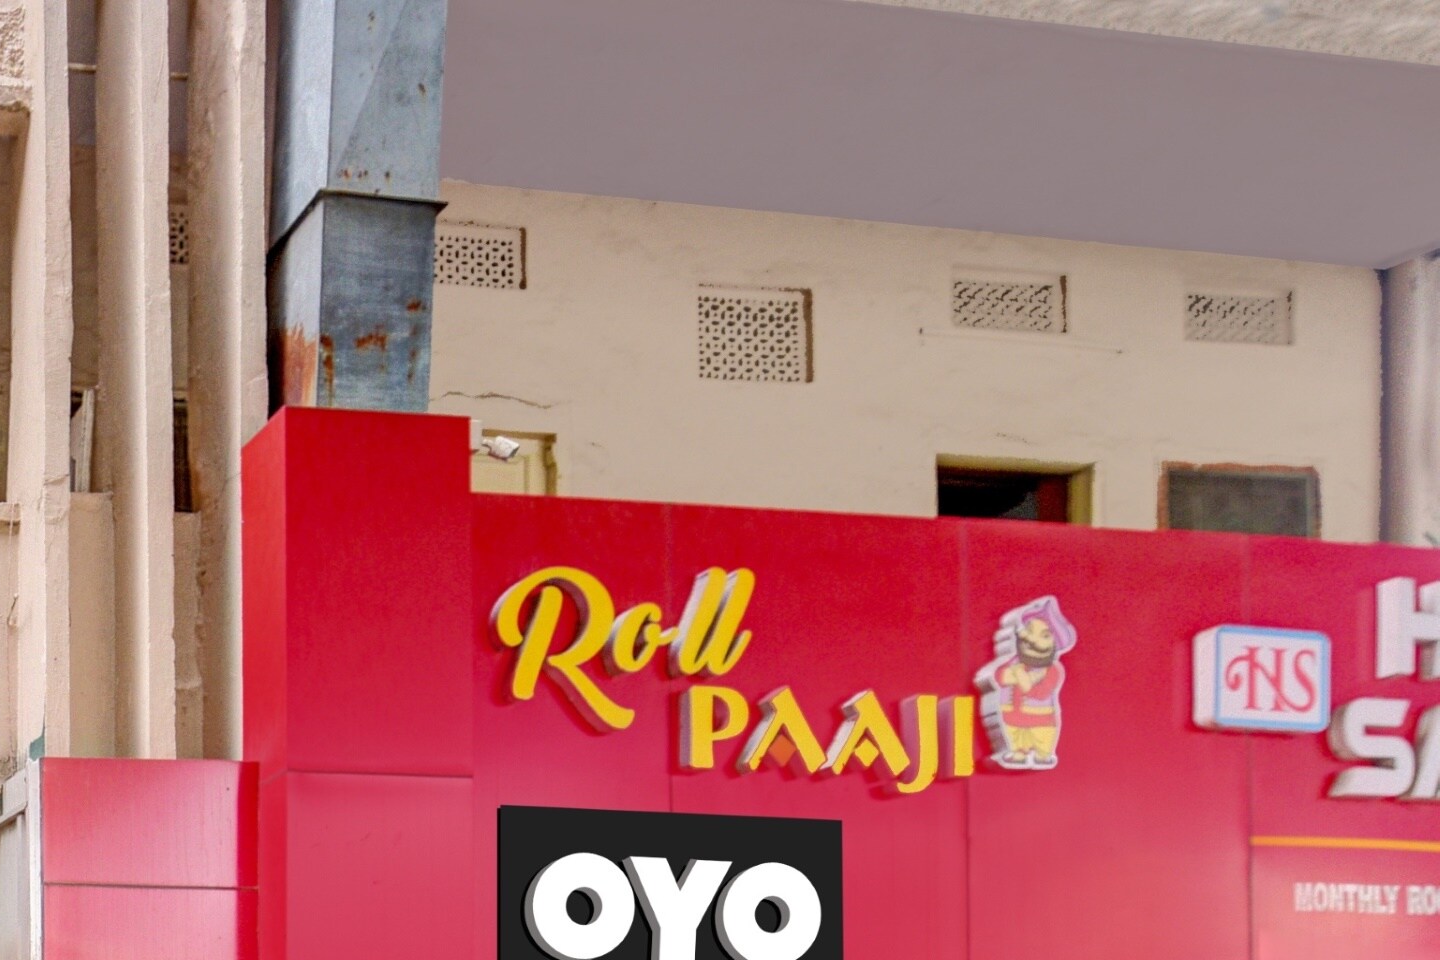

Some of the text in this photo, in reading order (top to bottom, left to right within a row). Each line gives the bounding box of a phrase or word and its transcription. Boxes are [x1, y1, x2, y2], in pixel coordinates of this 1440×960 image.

[491, 566, 756, 730] Roll
[679, 685, 974, 793] PAAJI
[1293, 882, 1440, 915] MONTHLY RO
